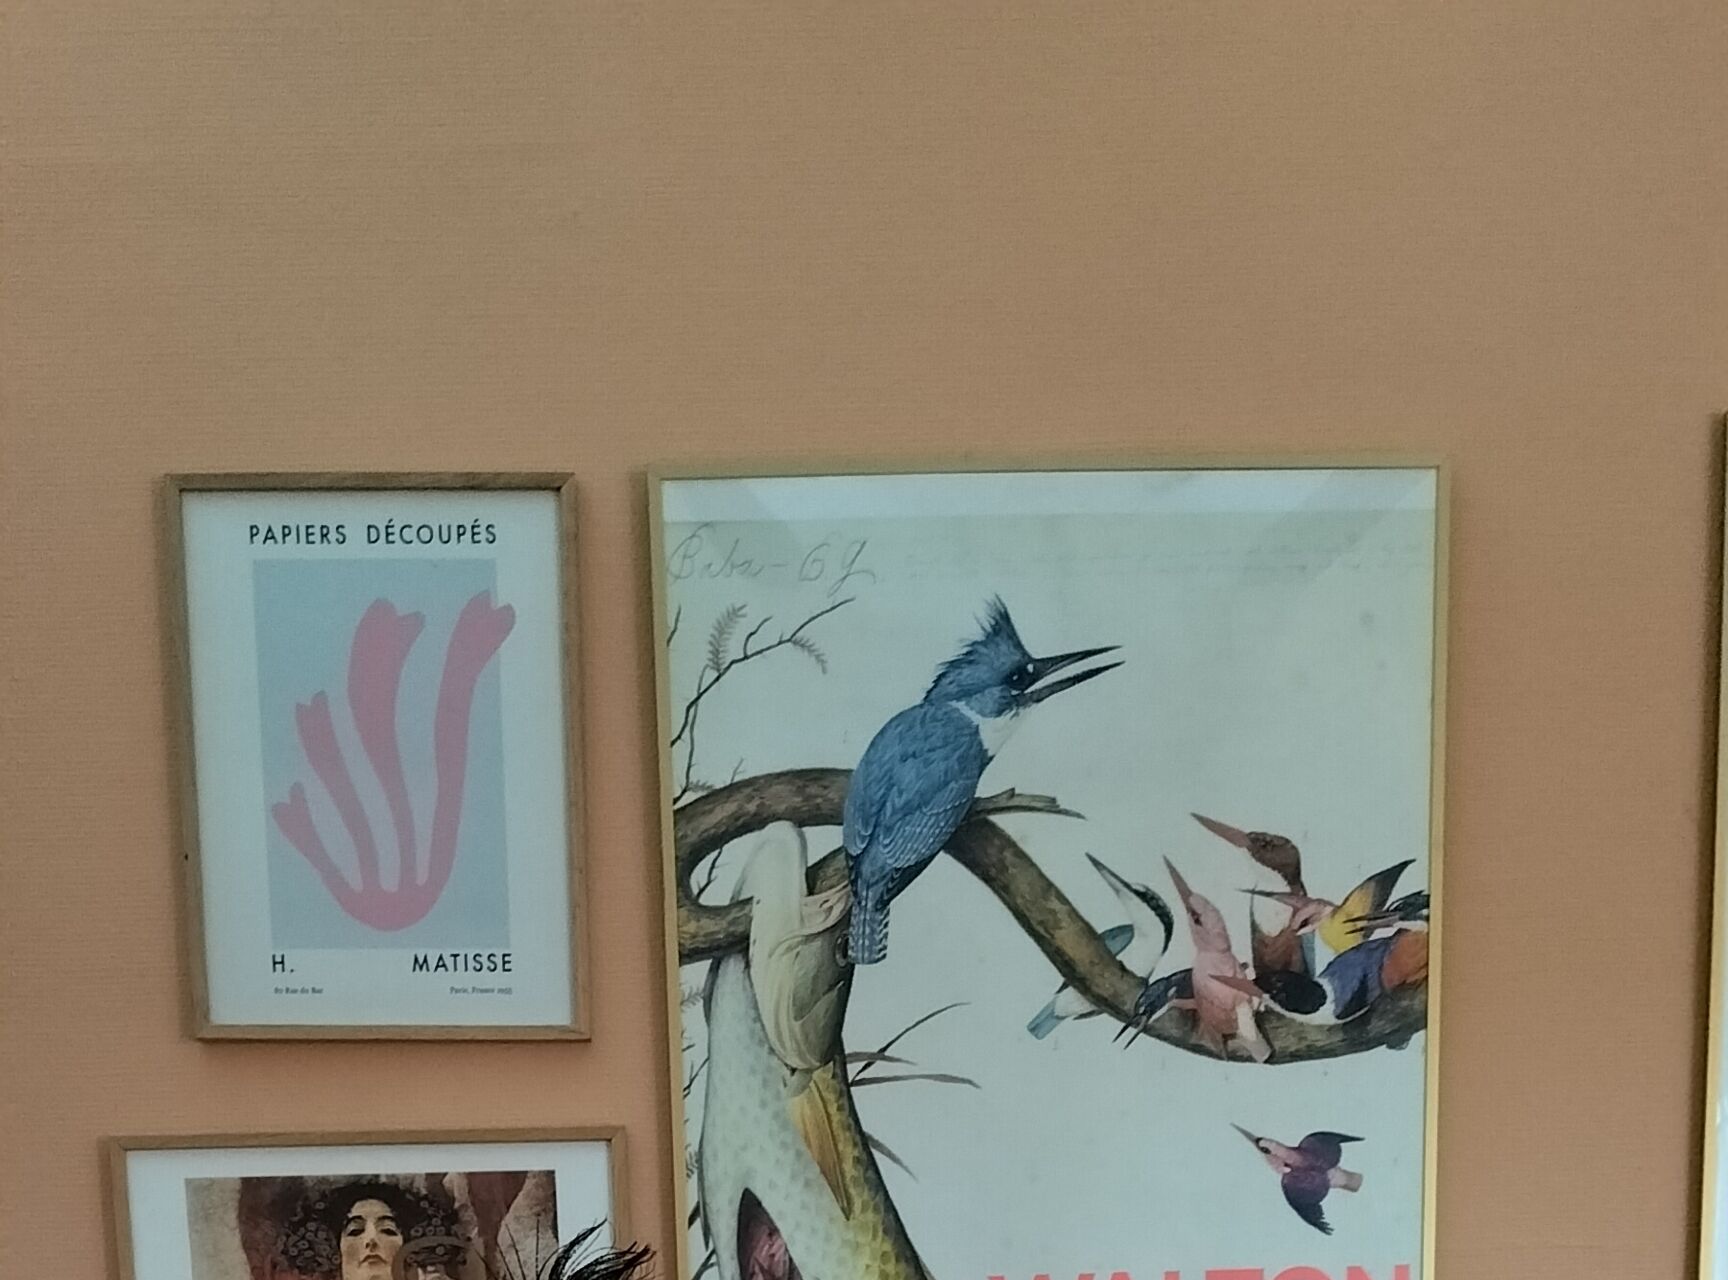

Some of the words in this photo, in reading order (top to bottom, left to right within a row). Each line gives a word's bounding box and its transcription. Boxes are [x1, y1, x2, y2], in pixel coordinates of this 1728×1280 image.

[249, 524, 347, 545] PAPIERS
[366, 518, 497, 545] DÉCOUPÉS
[272, 954, 294, 973] H.
[412, 953, 512, 973] MATISSE
